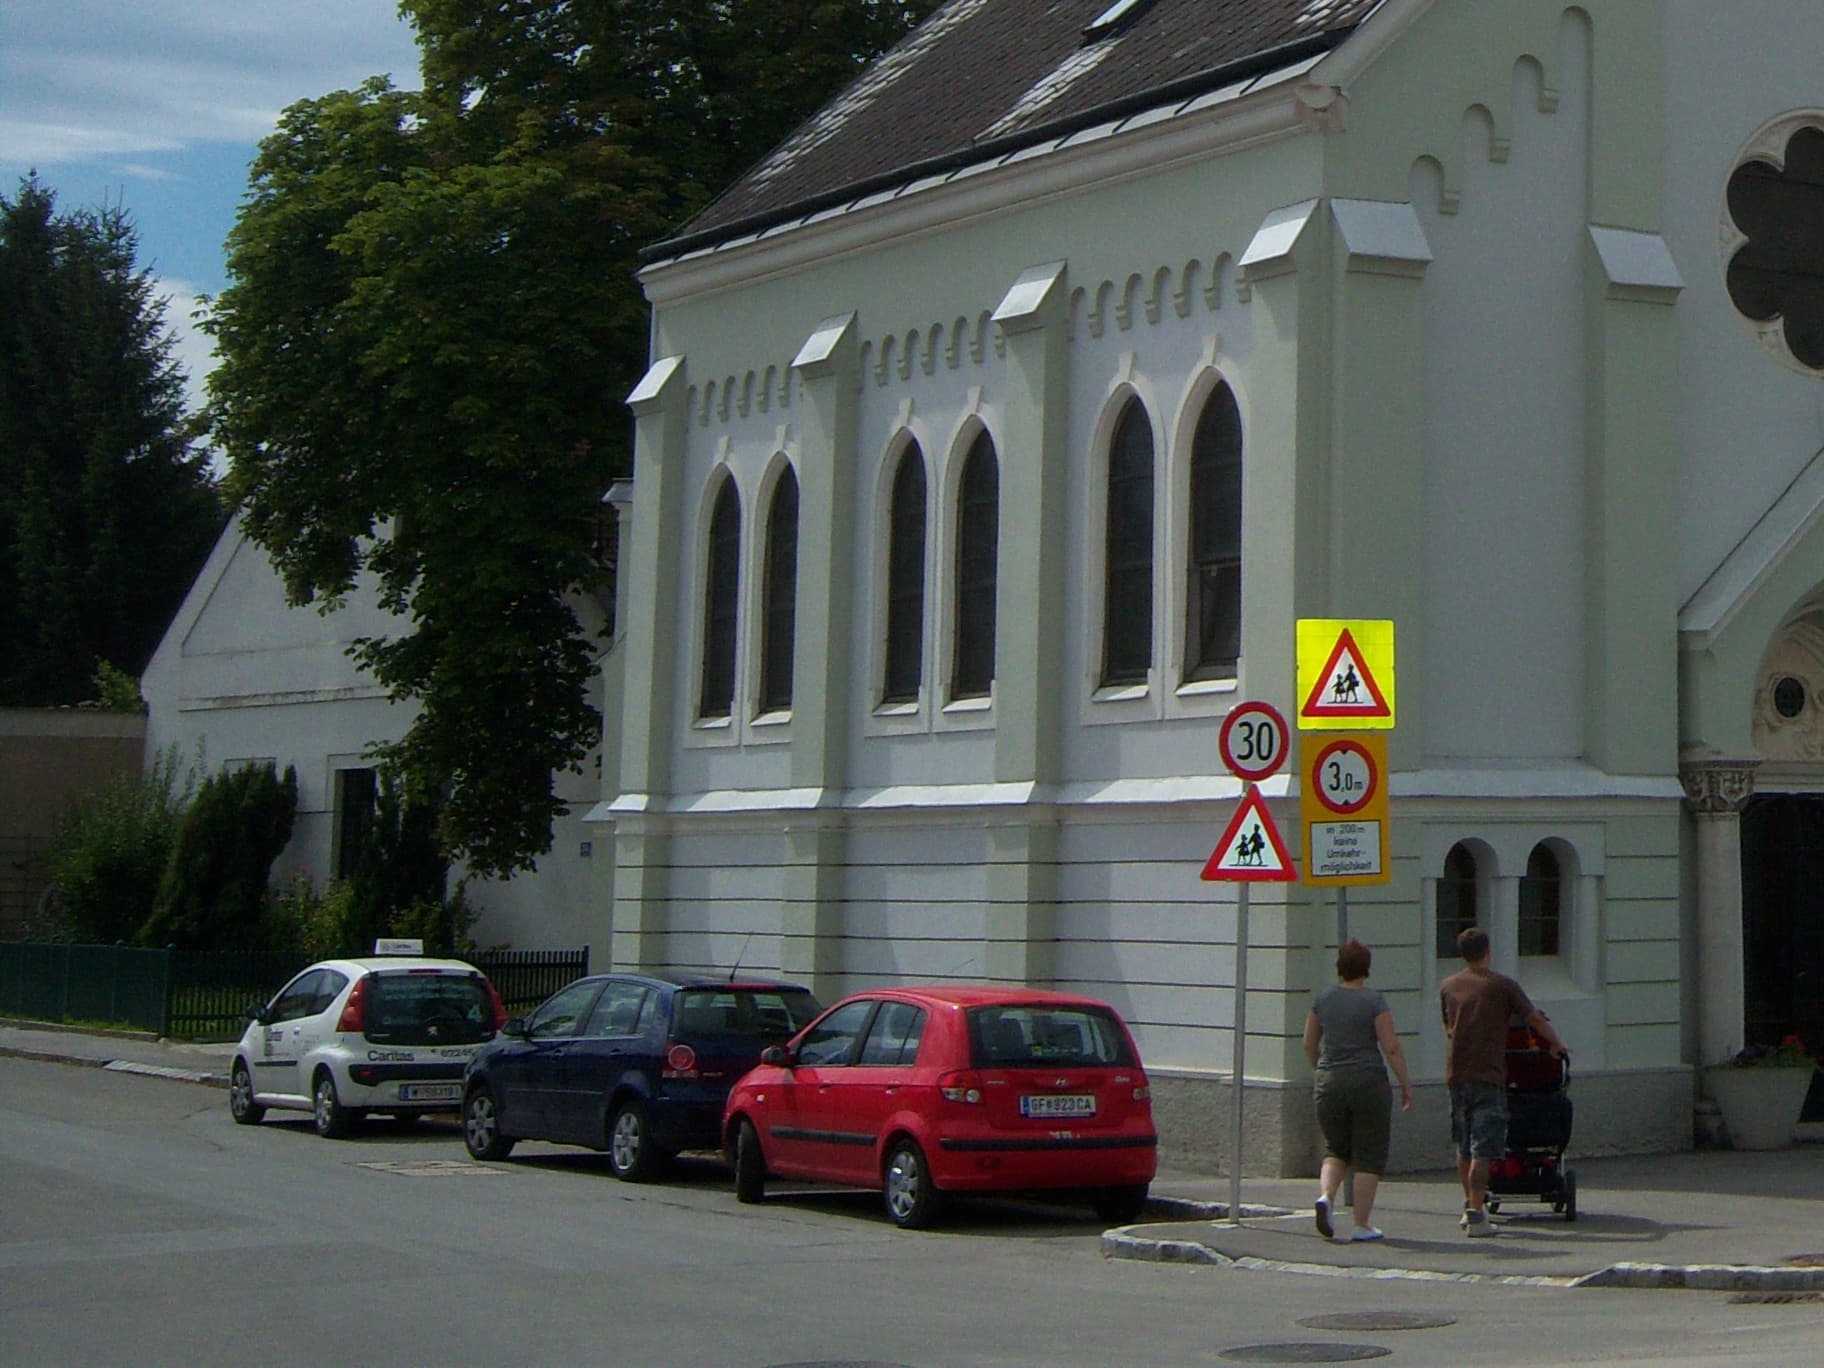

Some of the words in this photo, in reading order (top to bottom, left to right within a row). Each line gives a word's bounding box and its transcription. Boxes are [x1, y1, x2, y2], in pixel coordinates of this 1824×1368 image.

[1237, 721, 1274, 761] 30
[367, 1049, 415, 1062] Caritas
[1031, 1097, 1046, 1111] GF
